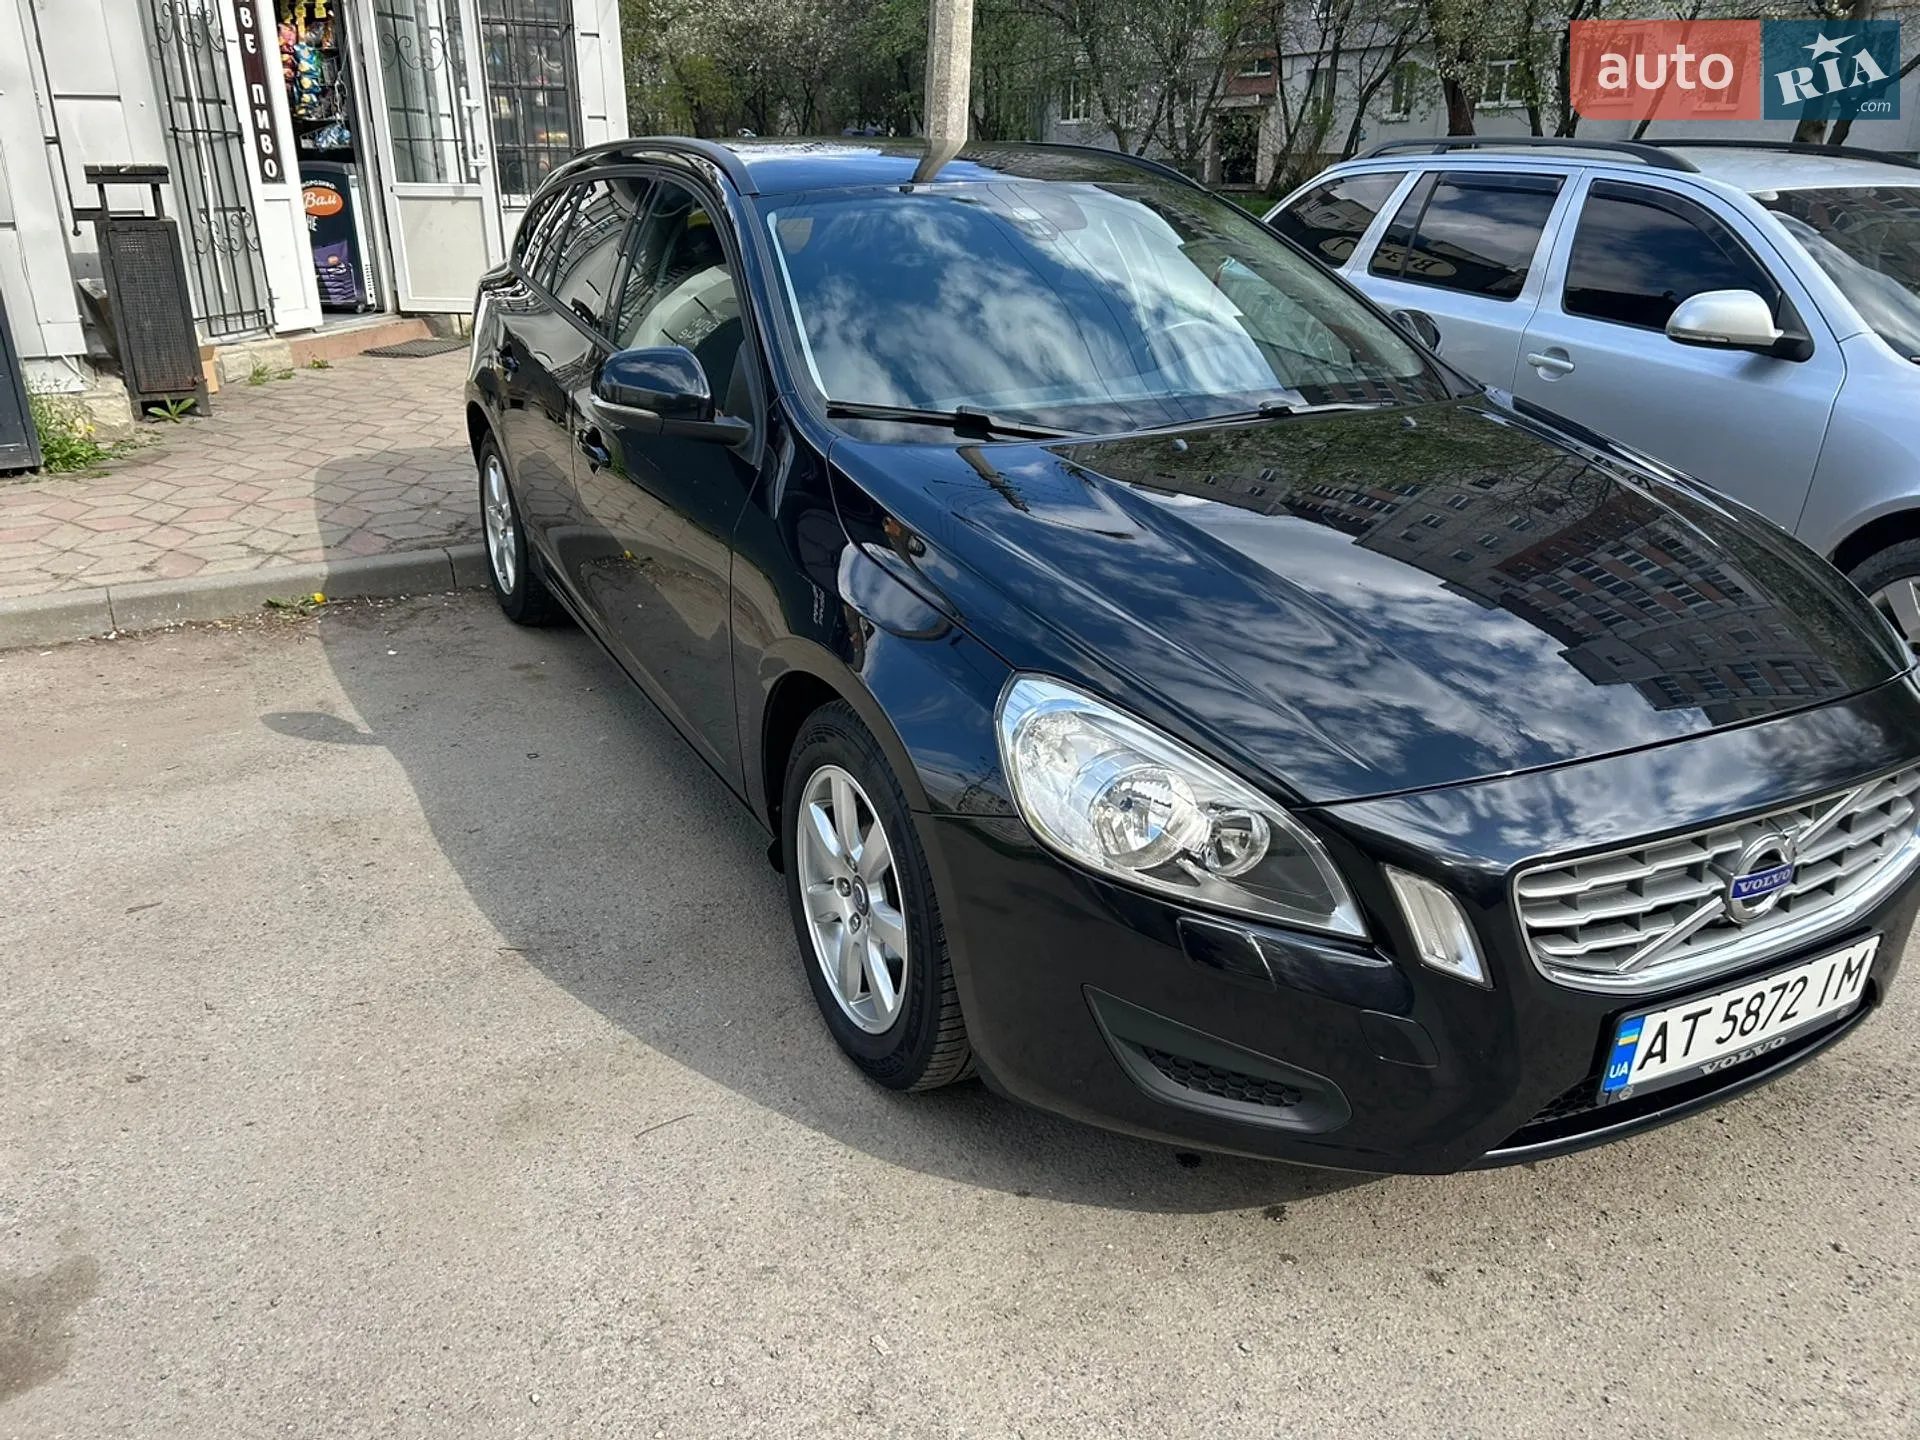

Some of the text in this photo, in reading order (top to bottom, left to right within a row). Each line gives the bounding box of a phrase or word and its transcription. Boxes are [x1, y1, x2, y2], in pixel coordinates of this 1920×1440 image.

[239, 0, 278, 178] ВЕ ПИВО
[1737, 868, 1791, 893] VOLVO
[1637, 949, 1870, 1071] AT 5872 IM
[1609, 1061, 1629, 1078] UA
[1699, 1036, 1787, 1075] VOLVO
